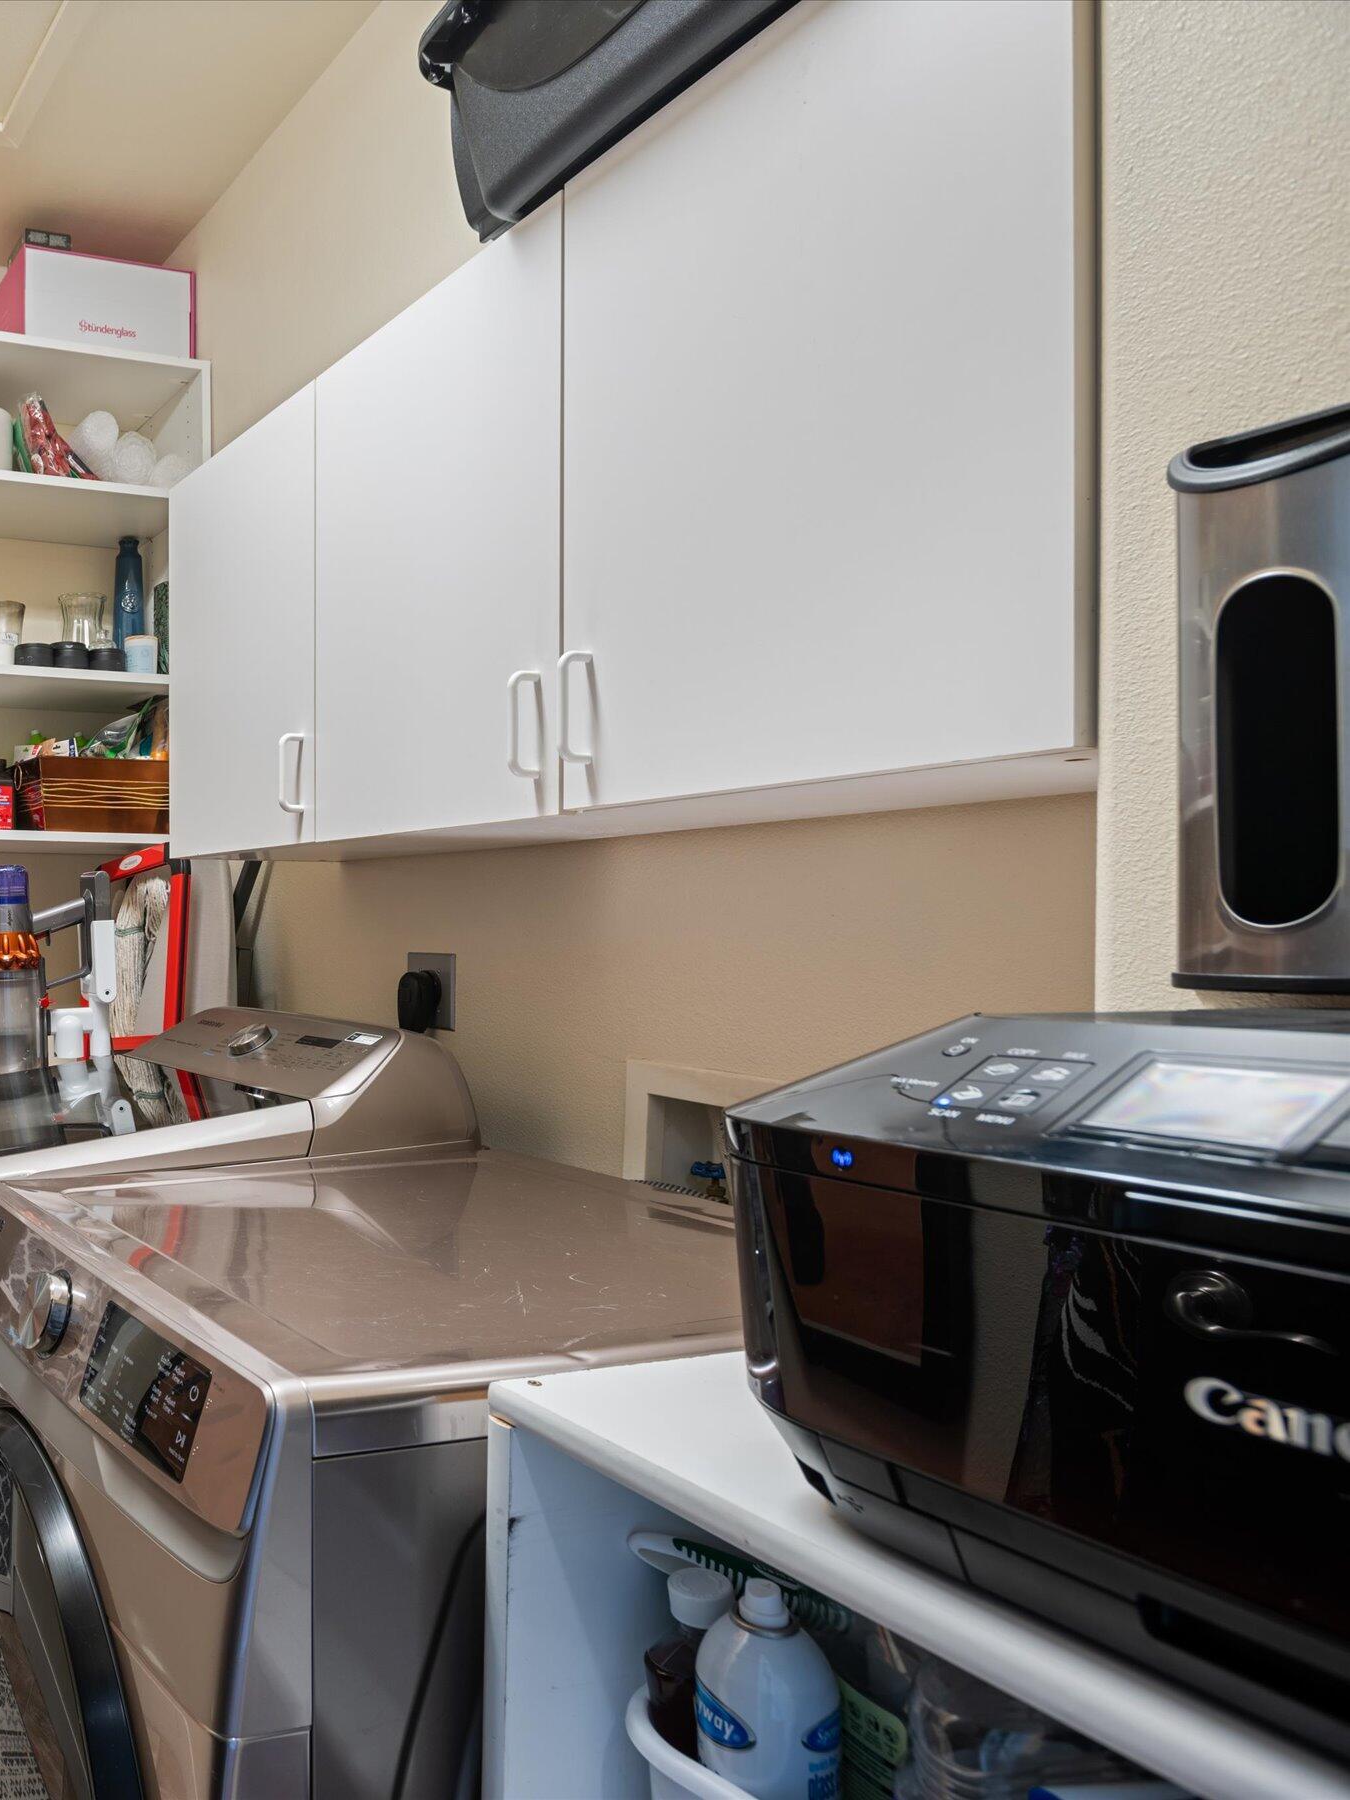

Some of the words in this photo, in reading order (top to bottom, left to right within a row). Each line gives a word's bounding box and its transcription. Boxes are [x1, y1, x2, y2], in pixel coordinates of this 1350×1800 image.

[1006, 1047, 1040, 1056] COPY
[927, 1108, 962, 1119] SCAN
[975, 1113, 1016, 1126] MENU
